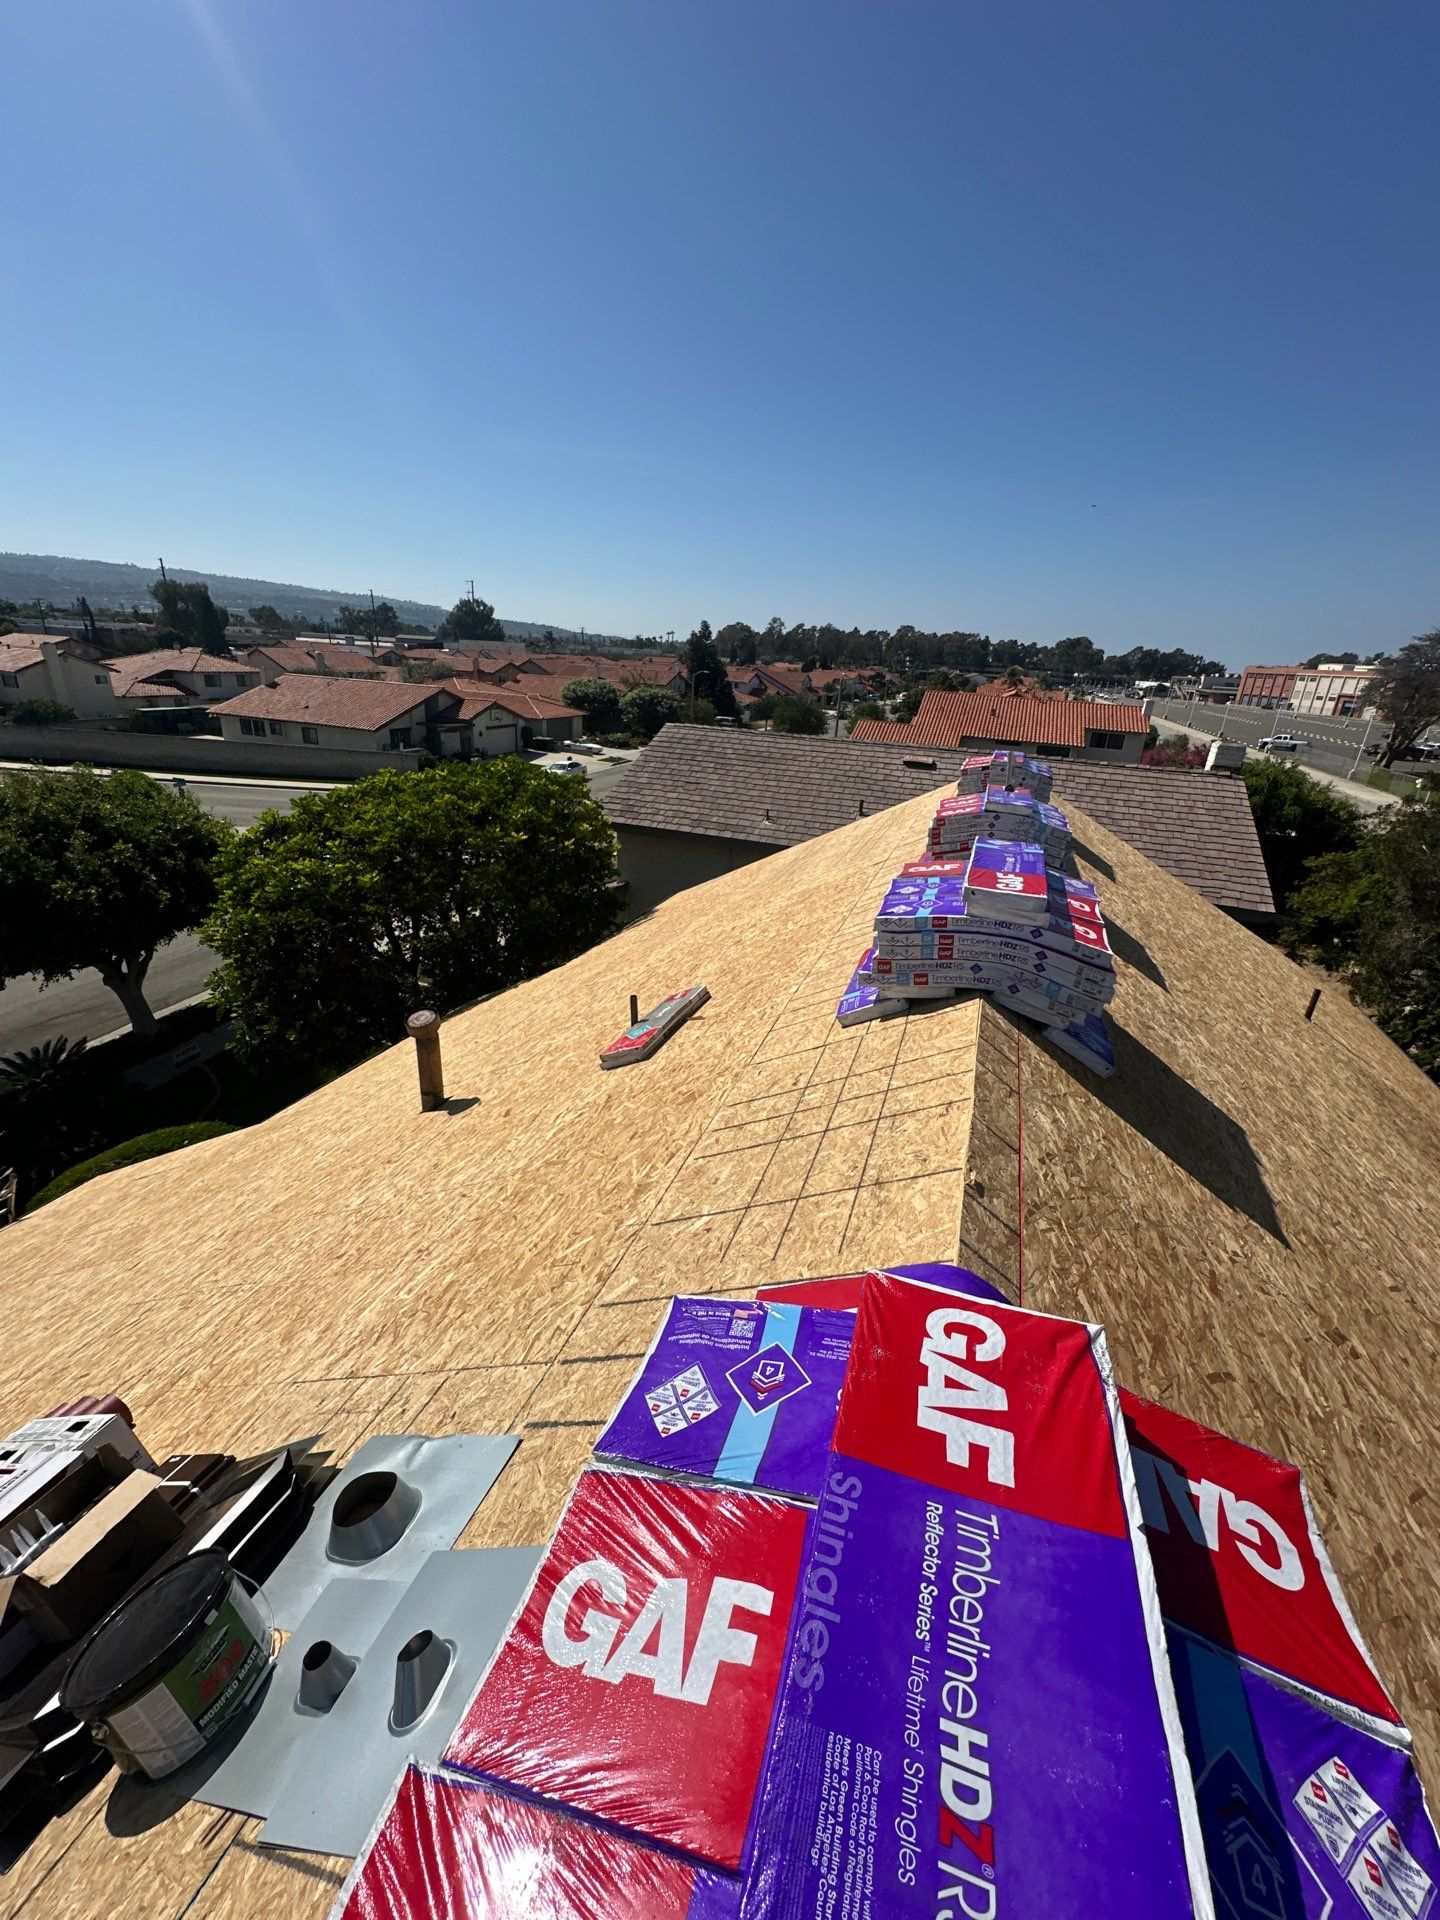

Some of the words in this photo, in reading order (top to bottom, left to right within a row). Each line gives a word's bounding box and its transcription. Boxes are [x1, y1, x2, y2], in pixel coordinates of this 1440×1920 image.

[908, 863, 961, 873] GAF
[995, 872, 1024, 890] GAF
[917, 1308, 1015, 1488] GAF
[922, 1501, 944, 1581] Reflector
[542, 1560, 774, 1706] GAF
[199, 1680, 239, 1727] MODIFIED
[237, 1645, 259, 1681] MASTIC
[822, 1731, 835, 1799] residential
[833, 1735, 843, 1770] Code
[842, 1737, 852, 1777] Meets
[864, 1746, 872, 1771] Part
[873, 1750, 882, 1776] Can
[832, 1773, 840, 1789] of
[854, 1743, 863, 1800] California
[872, 1778, 881, 1795] be
[829, 1790, 838, 1812] Los
[837, 1780, 848, 1821] Green
[861, 1785, 871, 1814] Cool
[869, 1797, 878, 1829] used
[811, 1801, 828, 1867] buildings
[850, 1802, 859, 1837] Code
[859, 1815, 868, 1846] Roof
[868, 1829, 876, 1843] to
[895, 1758, 924, 1886] Shingles
[821, 1814, 835, 1875] Angeles
[828, 1825, 843, 1886] Building
[849, 1840, 856, 1854] of
[864, 1845, 874, 1897] comply
